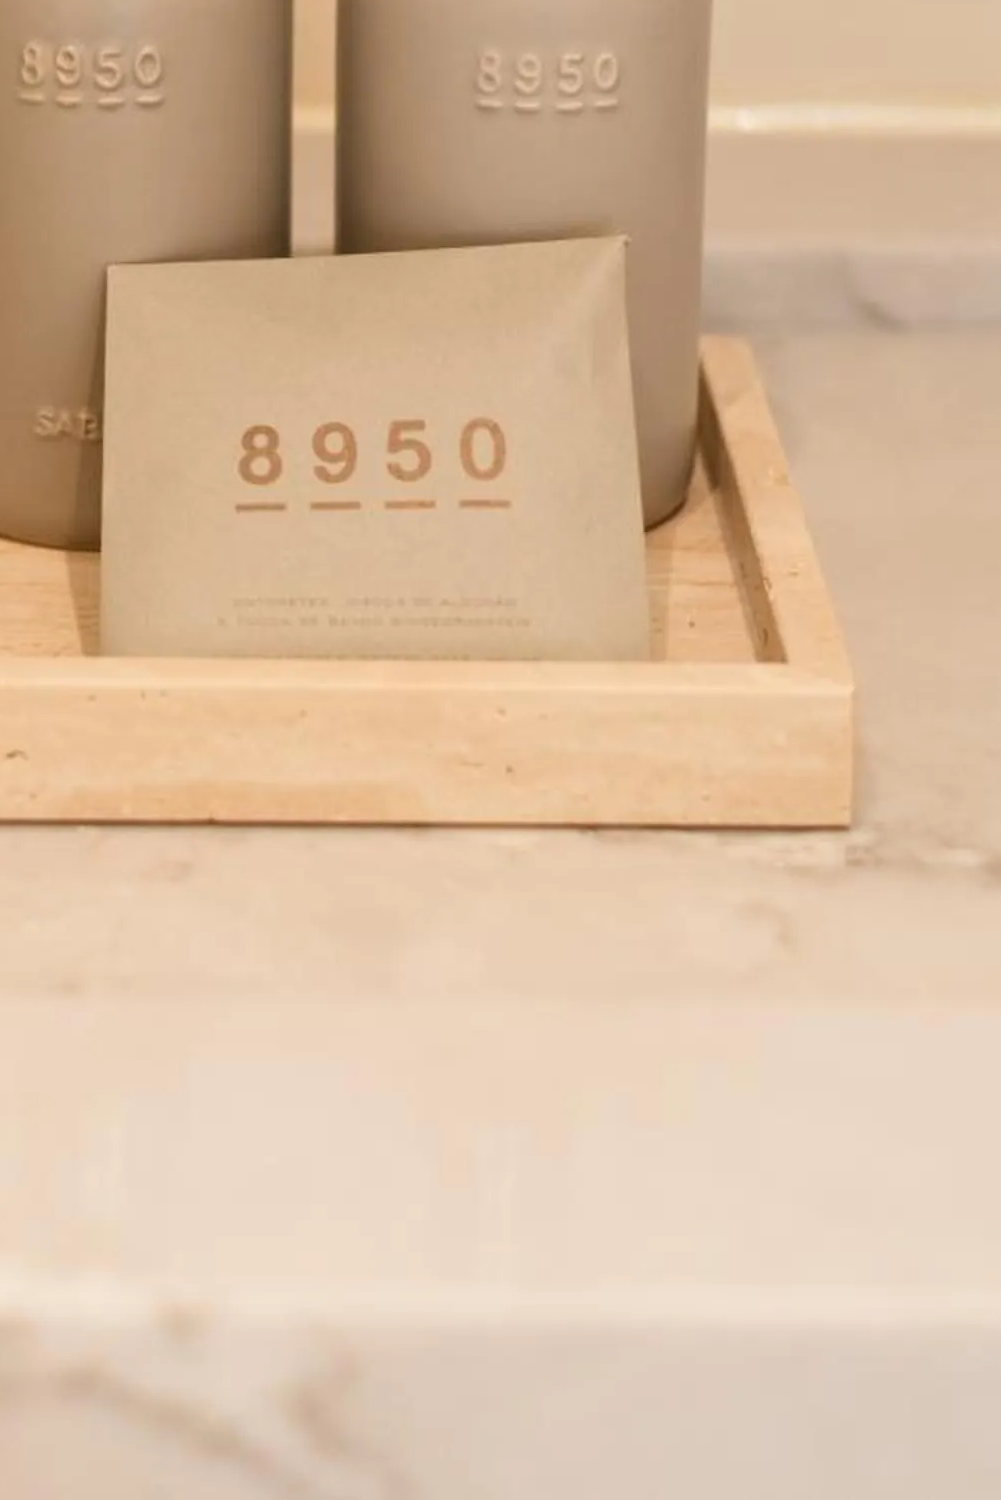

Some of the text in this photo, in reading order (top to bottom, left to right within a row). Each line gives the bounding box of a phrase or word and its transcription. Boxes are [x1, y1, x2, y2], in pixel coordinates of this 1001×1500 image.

[20, 40, 162, 89] 8950
[476, 50, 619, 94] 8950
[237, 417, 506, 485] 8950
